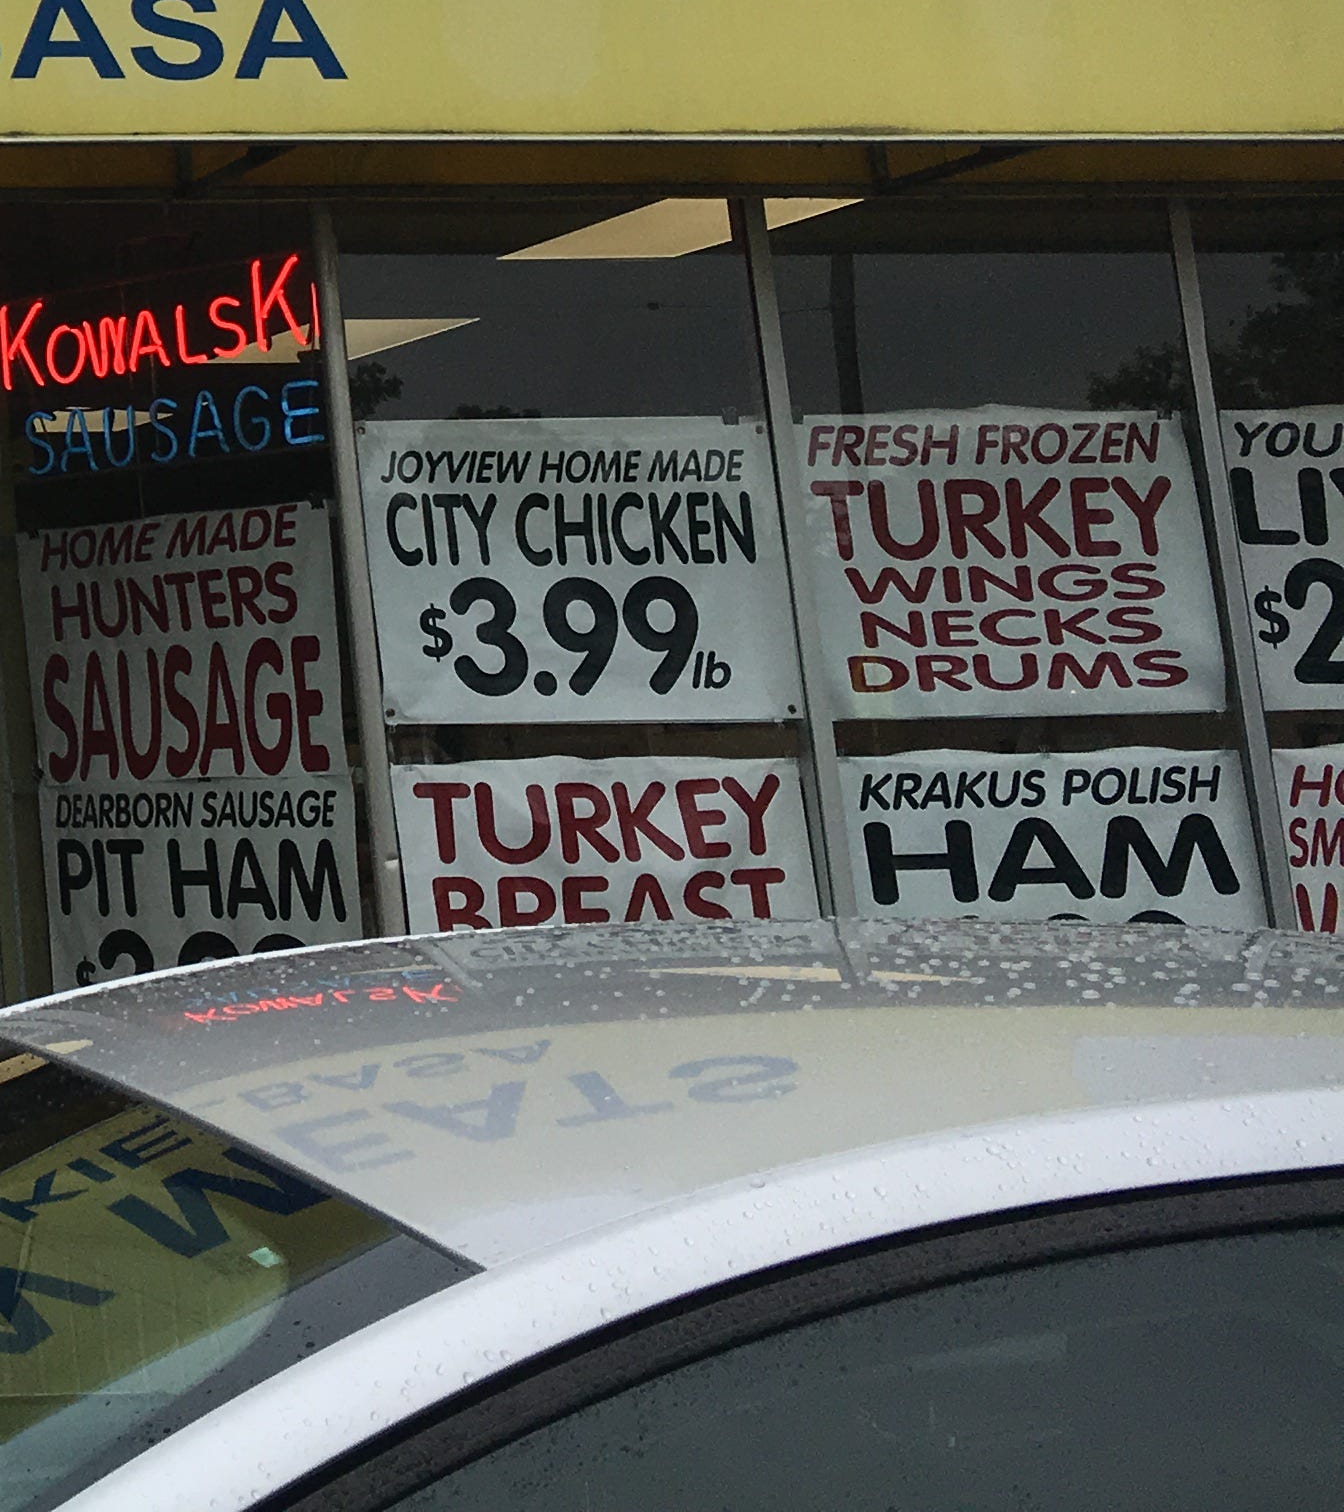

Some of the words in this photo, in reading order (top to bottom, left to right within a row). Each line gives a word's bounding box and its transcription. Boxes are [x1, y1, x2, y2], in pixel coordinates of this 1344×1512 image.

[25, 380, 325, 476] SAUSAGE
[807, 423, 960, 468] FRESH
[975, 422, 1161, 466] FROZEN
[381, 450, 532, 484] JOYVIEW
[538, 450, 641, 483] HOME
[648, 448, 745, 482] MADE
[41, 522, 160, 573] HOME
[166, 504, 298, 559] MADE
[386, 491, 497, 567] CITY
[515, 490, 758, 568] CHICKEN
[810, 475, 1173, 562] TURKEY
[51, 561, 298, 642] HUNTERS
[844, 562, 1166, 605] WINGS
[860, 606, 1163, 650] NECKS
[847, 650, 1189, 694] DRUMS
[43, 635, 331, 784] SAUSAGE
[55, 791, 193, 829] DEARBORN
[201, 790, 337, 828] SAUSAGE
[412, 773, 782, 865] TURKEY
[859, 769, 1047, 811] KRAKUS
[1062, 765, 1222, 807] POLISH
[57, 838, 145, 917] PIT
[167, 838, 347, 922] HAM
[862, 813, 1242, 906] HAM
